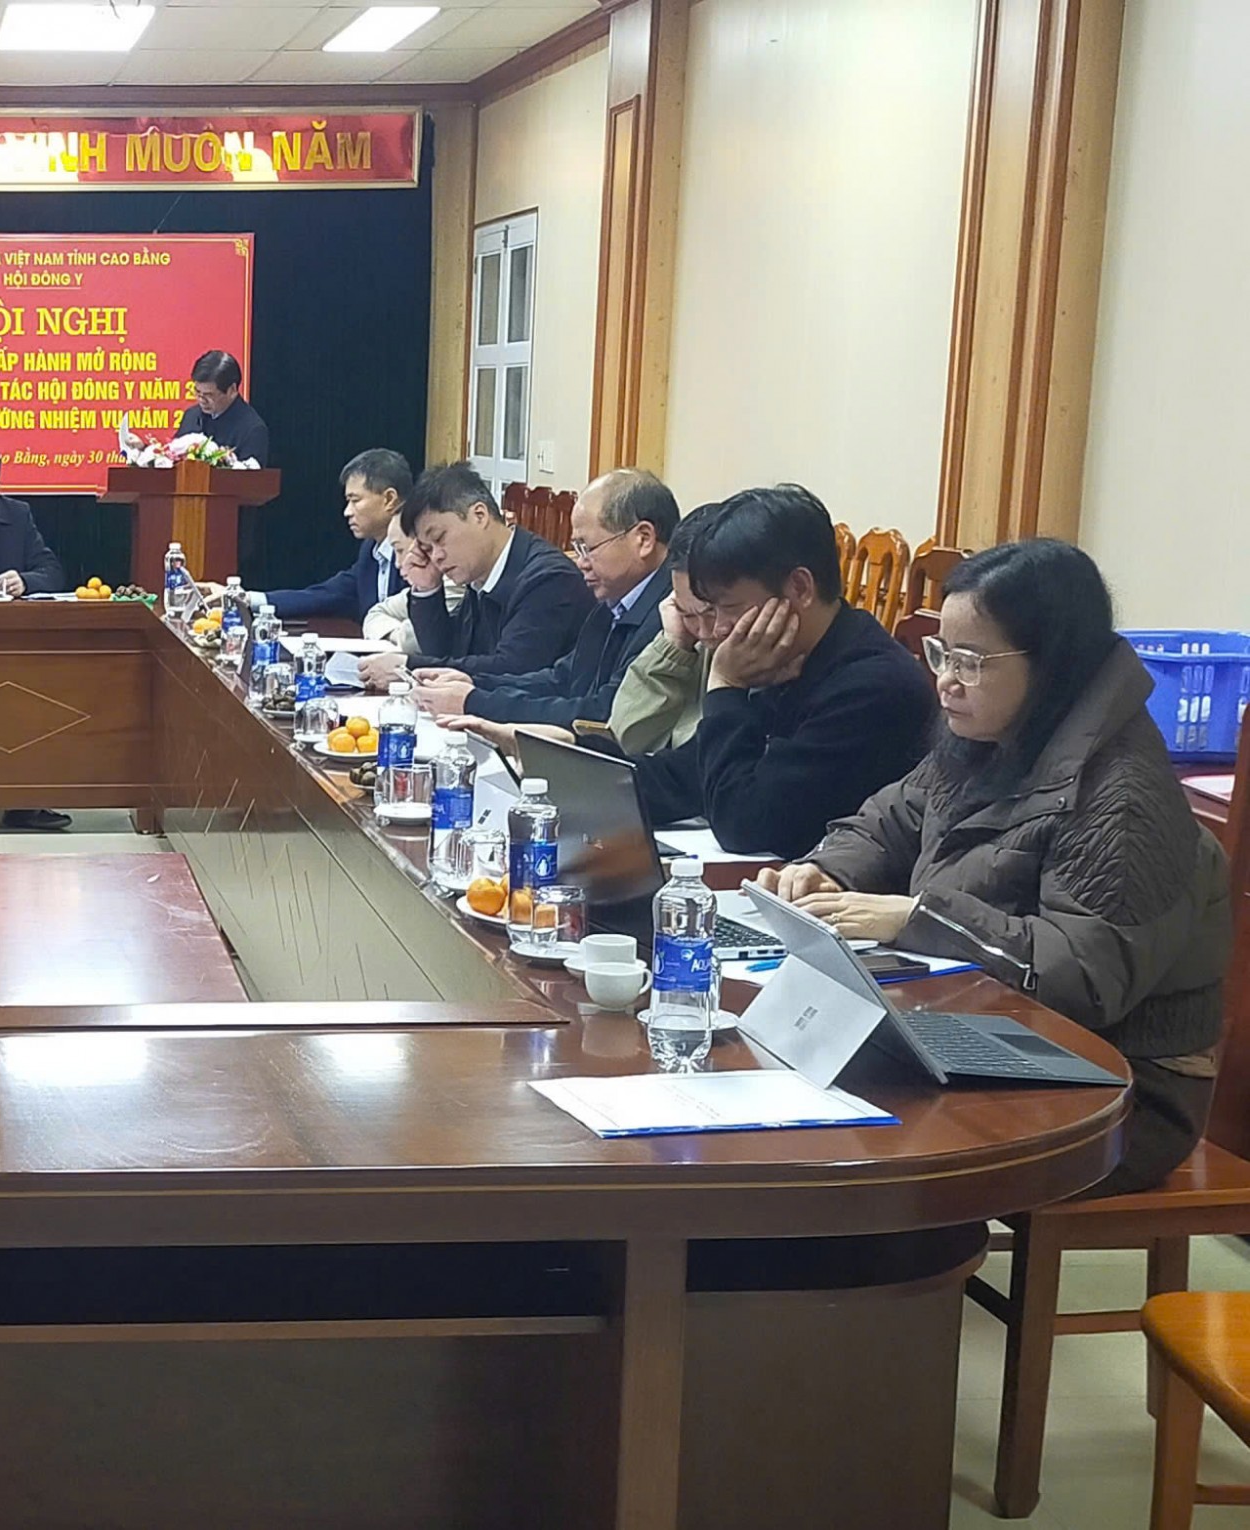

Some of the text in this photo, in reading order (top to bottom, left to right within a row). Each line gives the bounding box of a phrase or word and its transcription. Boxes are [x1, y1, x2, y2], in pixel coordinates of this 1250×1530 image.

[126, 122, 253, 172] MUÔN
[272, 119, 371, 171] NĂM
[4, 249, 30, 269] VIỆT
[33, 252, 64, 266] NAM
[67, 248, 96, 266] TỈNH
[100, 252, 130, 266] CAO
[133, 246, 170, 266] BẰNG
[3, 270, 83, 288] HỘI ĐÔNG Y
[36, 307, 128, 344] NGHỊ
[23, 349, 71, 372] HÀNH
[77, 346, 105, 371] MỞ
[109, 349, 157, 375] RỘNG
[0, 378, 33, 400] TÁC
[38, 378, 67, 404] HỘI
[71, 378, 119, 400] ĐÔNG
[124, 382, 135, 400] Y
[140, 378, 180, 400] NĂM
[40, 407, 96, 432] NHIỆM
[101, 410, 124, 432] VỤ
[128, 407, 169, 429] NĂM
[53, 450, 85, 467] ngày
[87, 450, 104, 464] 30
